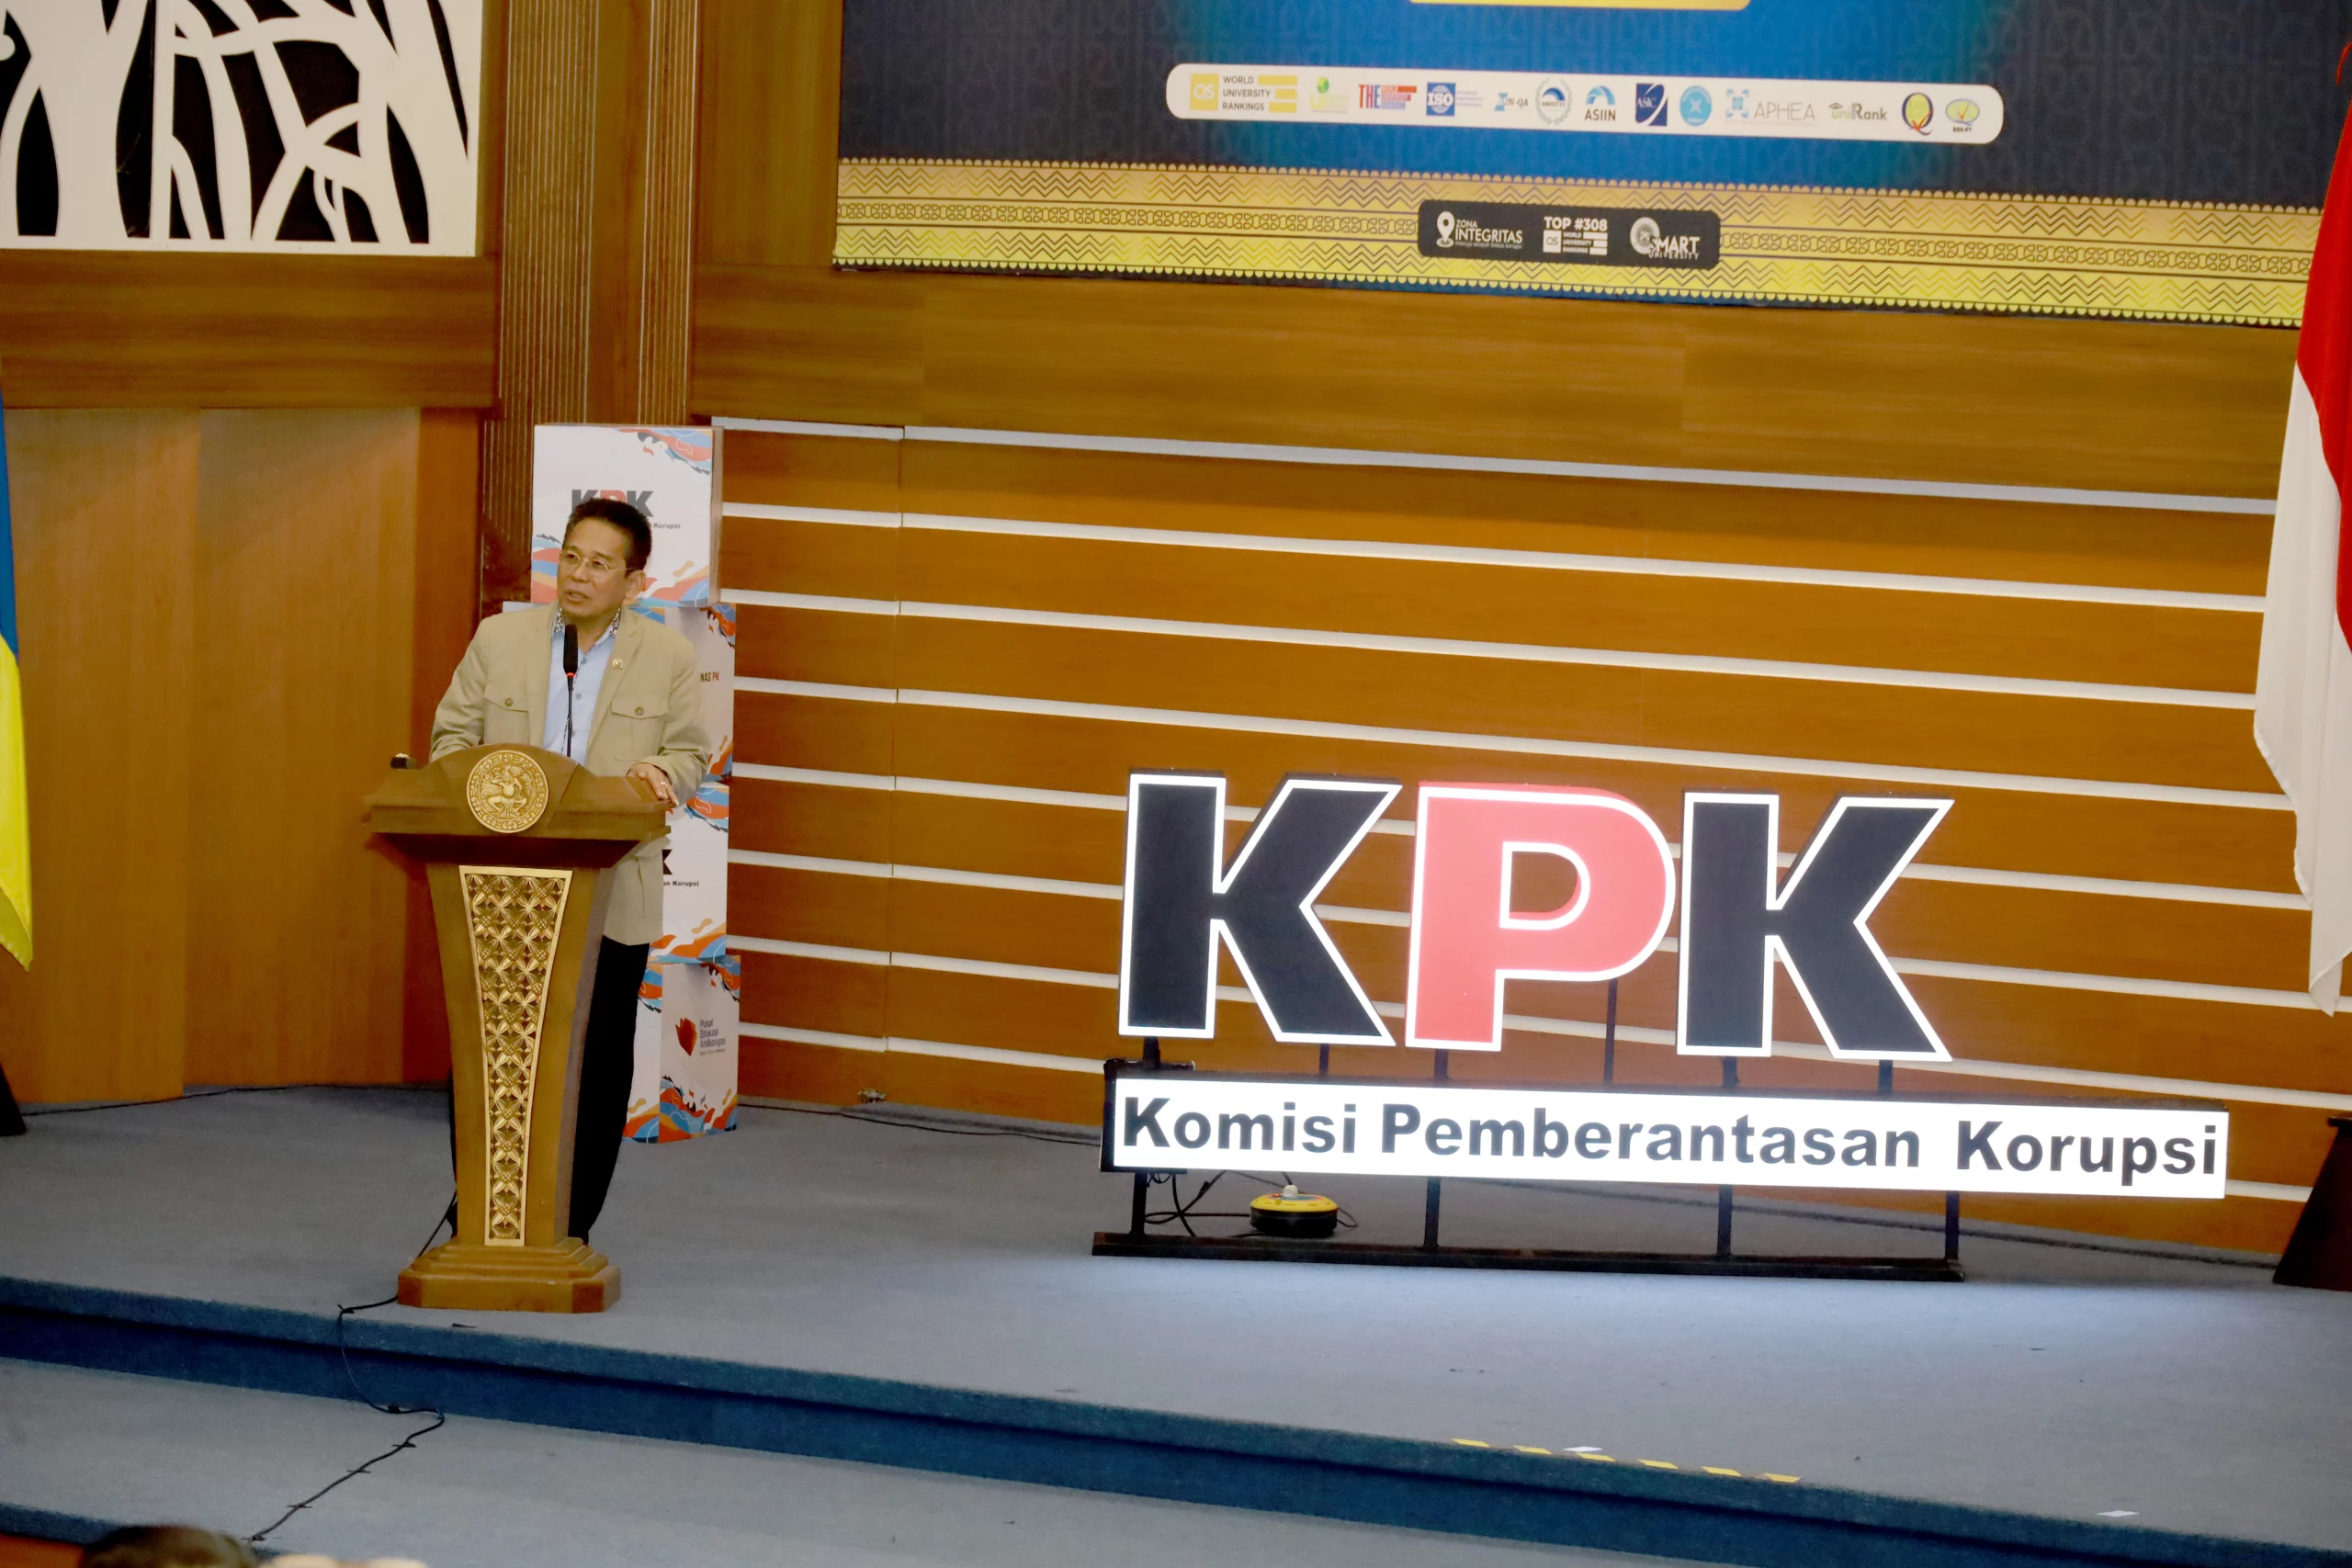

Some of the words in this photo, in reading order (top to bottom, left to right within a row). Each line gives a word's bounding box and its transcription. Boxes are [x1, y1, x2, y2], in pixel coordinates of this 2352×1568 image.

[1223, 75, 1253, 85] WORLD
[1223, 89, 1271, 98] UNIVERSITY
[1358, 84, 1381, 109] THE
[1427, 92, 1454, 107] ISO
[1222, 102, 1265, 111] RANKINGS
[1753, 101, 1816, 121] APHEA
[1584, 108, 1616, 121] ASIIN
[1455, 220, 1478, 228] ZONA
[1544, 216, 1572, 230] TOP
[1574, 218, 1608, 231] #308
[1454, 228, 1523, 244] INTEGRITAS
[1119, 773, 1955, 1062] KPK
[1123, 1097, 1357, 1154] Komisi
[1381, 1103, 1920, 1168] Pemberantasan
[1957, 1120, 2216, 1187] Korupsi
